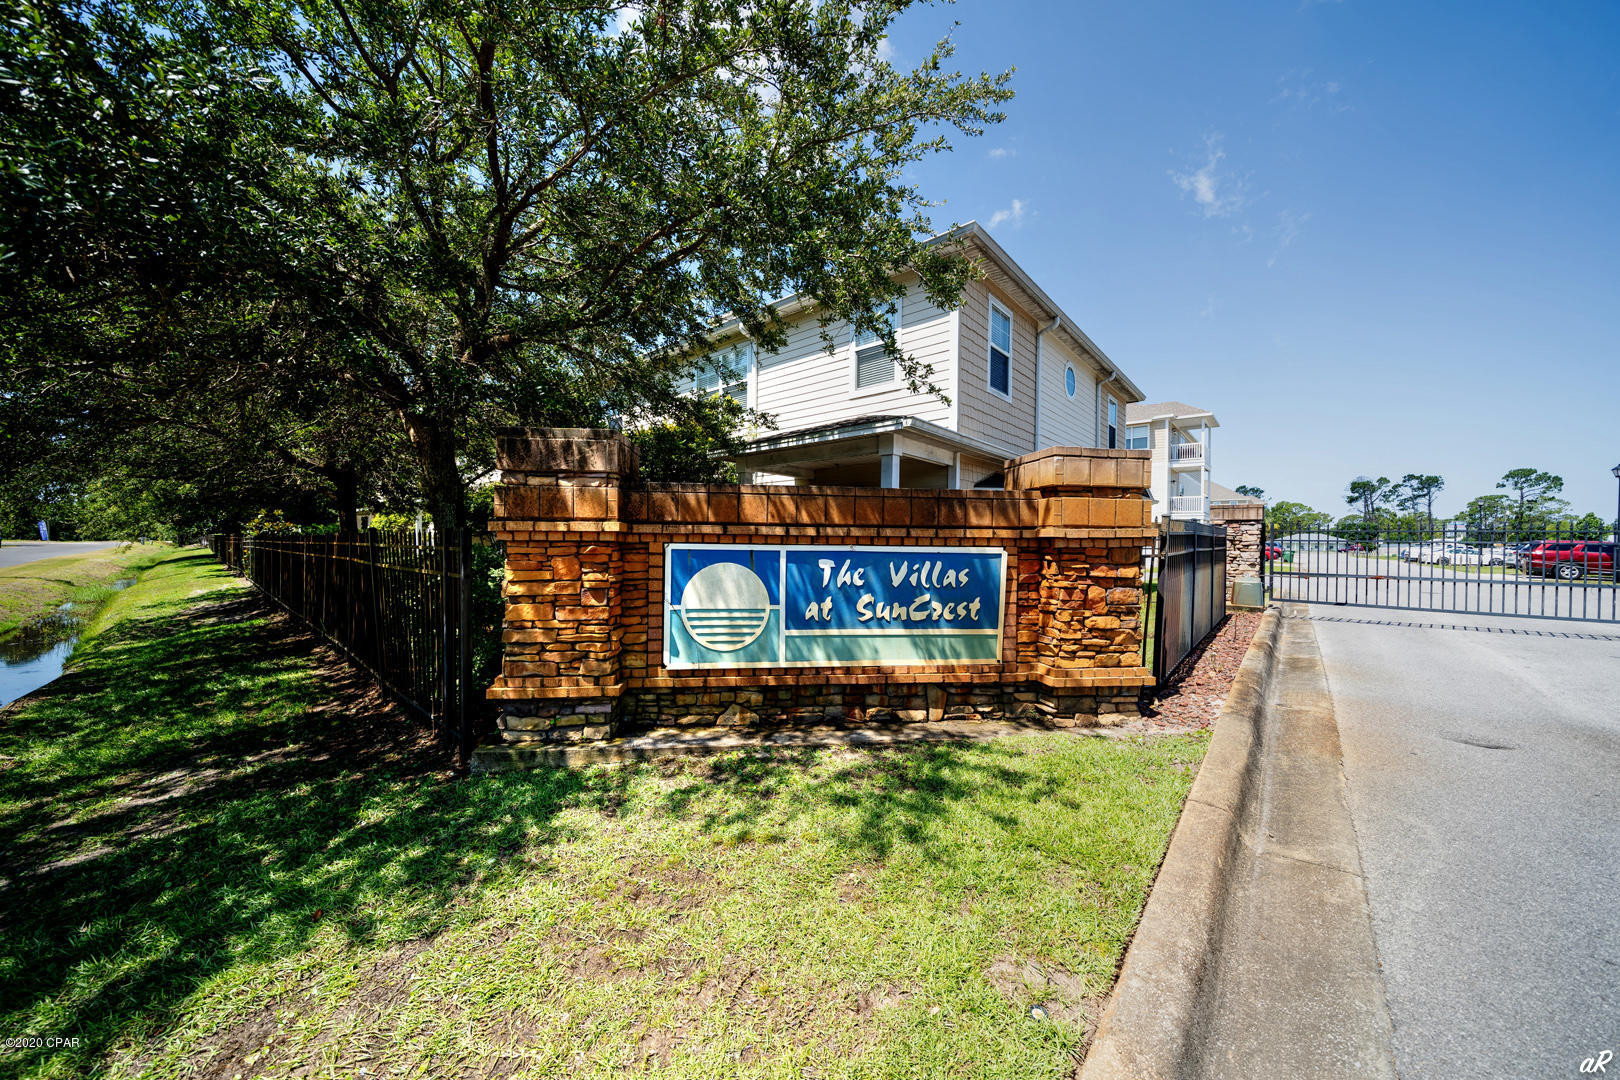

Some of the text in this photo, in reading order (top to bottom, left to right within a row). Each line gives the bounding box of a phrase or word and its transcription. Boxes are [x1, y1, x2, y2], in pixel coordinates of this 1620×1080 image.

[818, 558, 970, 589] The Villas
[805, 593, 981, 625] at SunCrest
